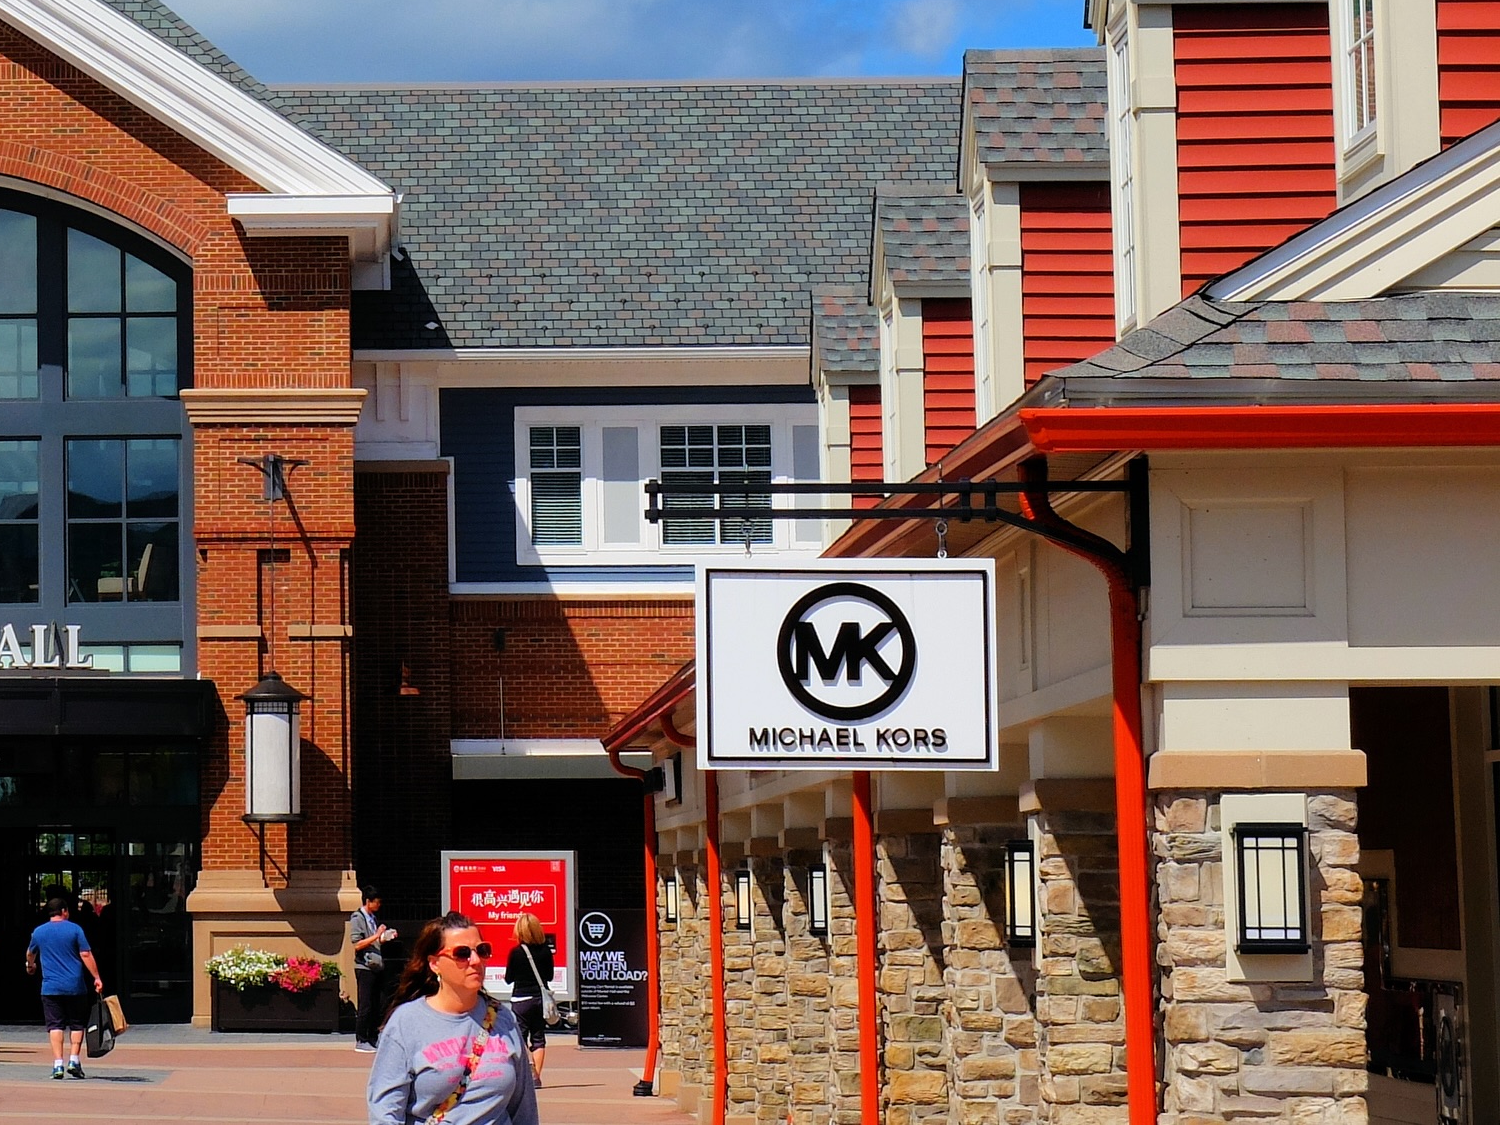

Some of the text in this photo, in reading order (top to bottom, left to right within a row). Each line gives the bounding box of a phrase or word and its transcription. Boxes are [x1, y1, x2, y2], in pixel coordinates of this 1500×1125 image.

[795, 621, 899, 681] MK
[749, 727, 947, 748] MICHAEL KORS
[470, 889, 544, 909] 很高兴遇见你
[488, 912, 499, 921] My
[580, 951, 625, 961] MAY WE
[580, 961, 627, 971] LIGHTEN
[580, 970, 648, 982] YOUR LOAD?
